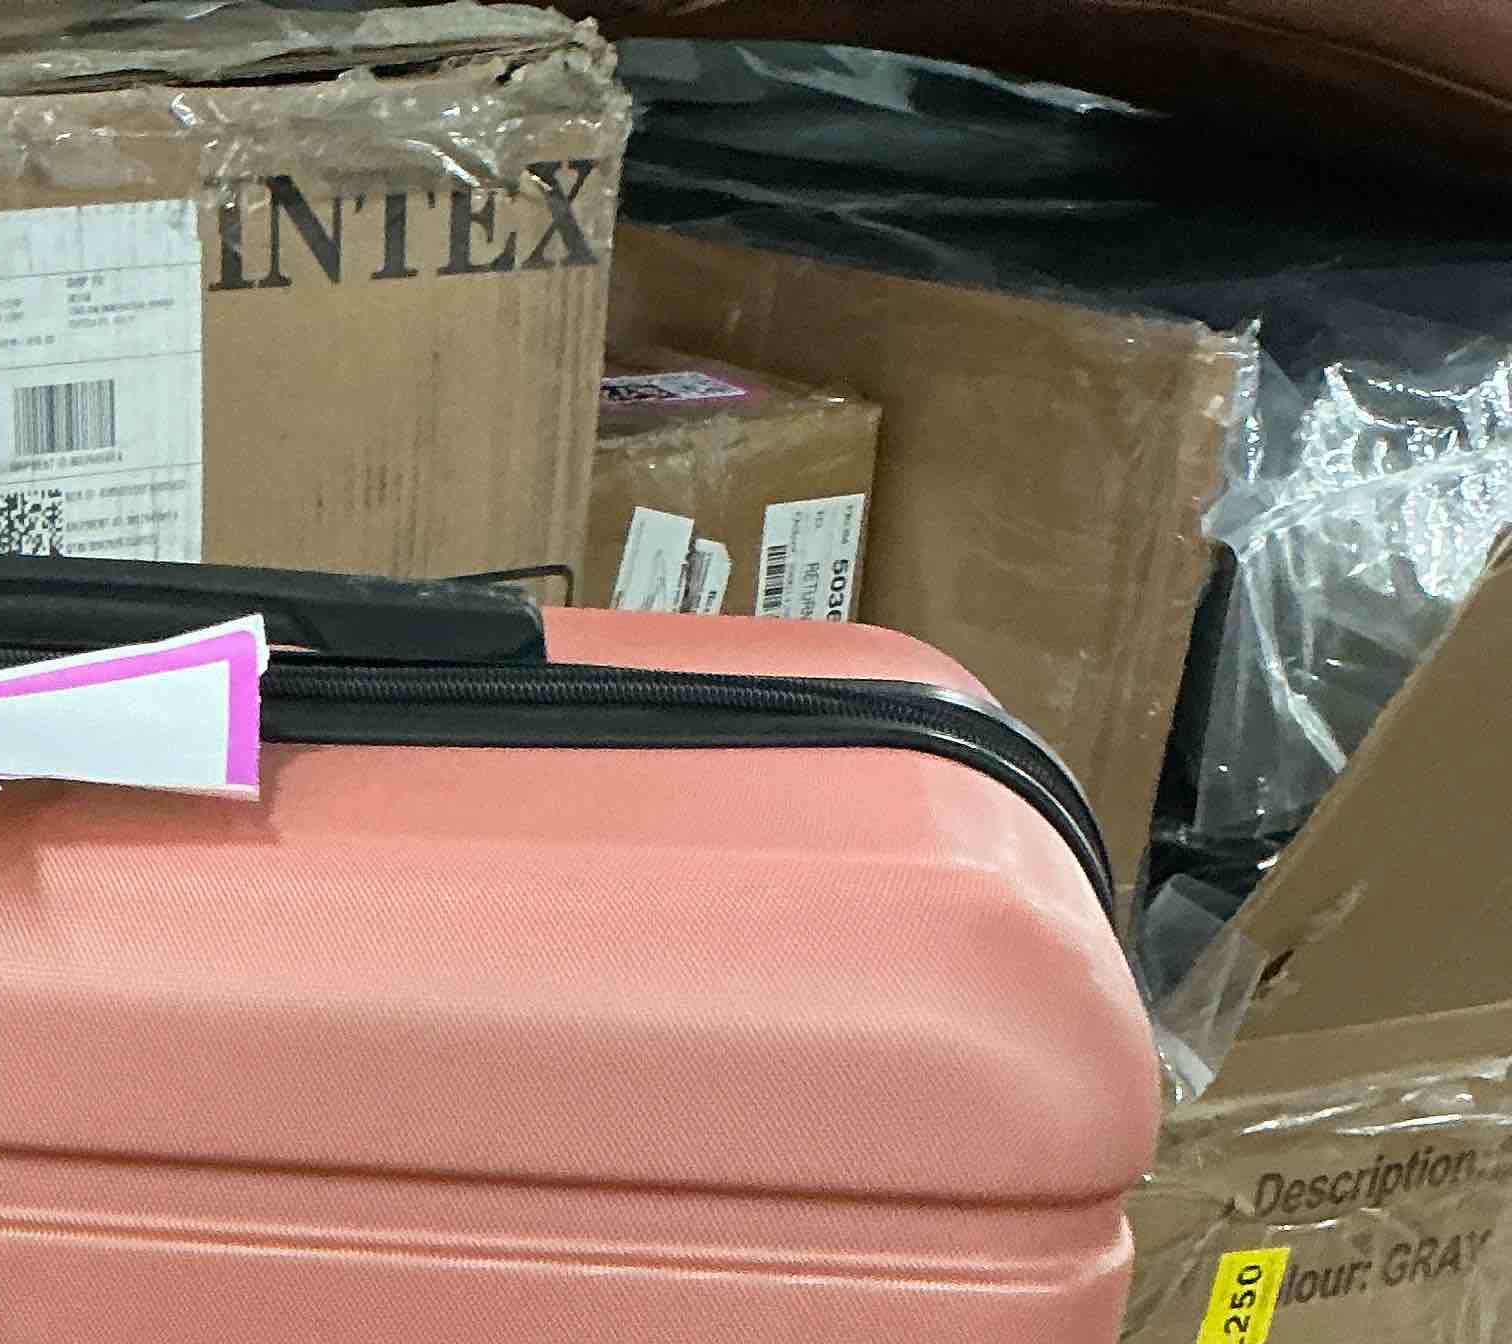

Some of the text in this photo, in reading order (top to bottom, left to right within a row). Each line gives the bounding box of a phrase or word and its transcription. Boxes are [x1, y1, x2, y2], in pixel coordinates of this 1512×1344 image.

[206, 159, 600, 292] INTEX
[1278, 1228, 1493, 1307] lour: GRAY
